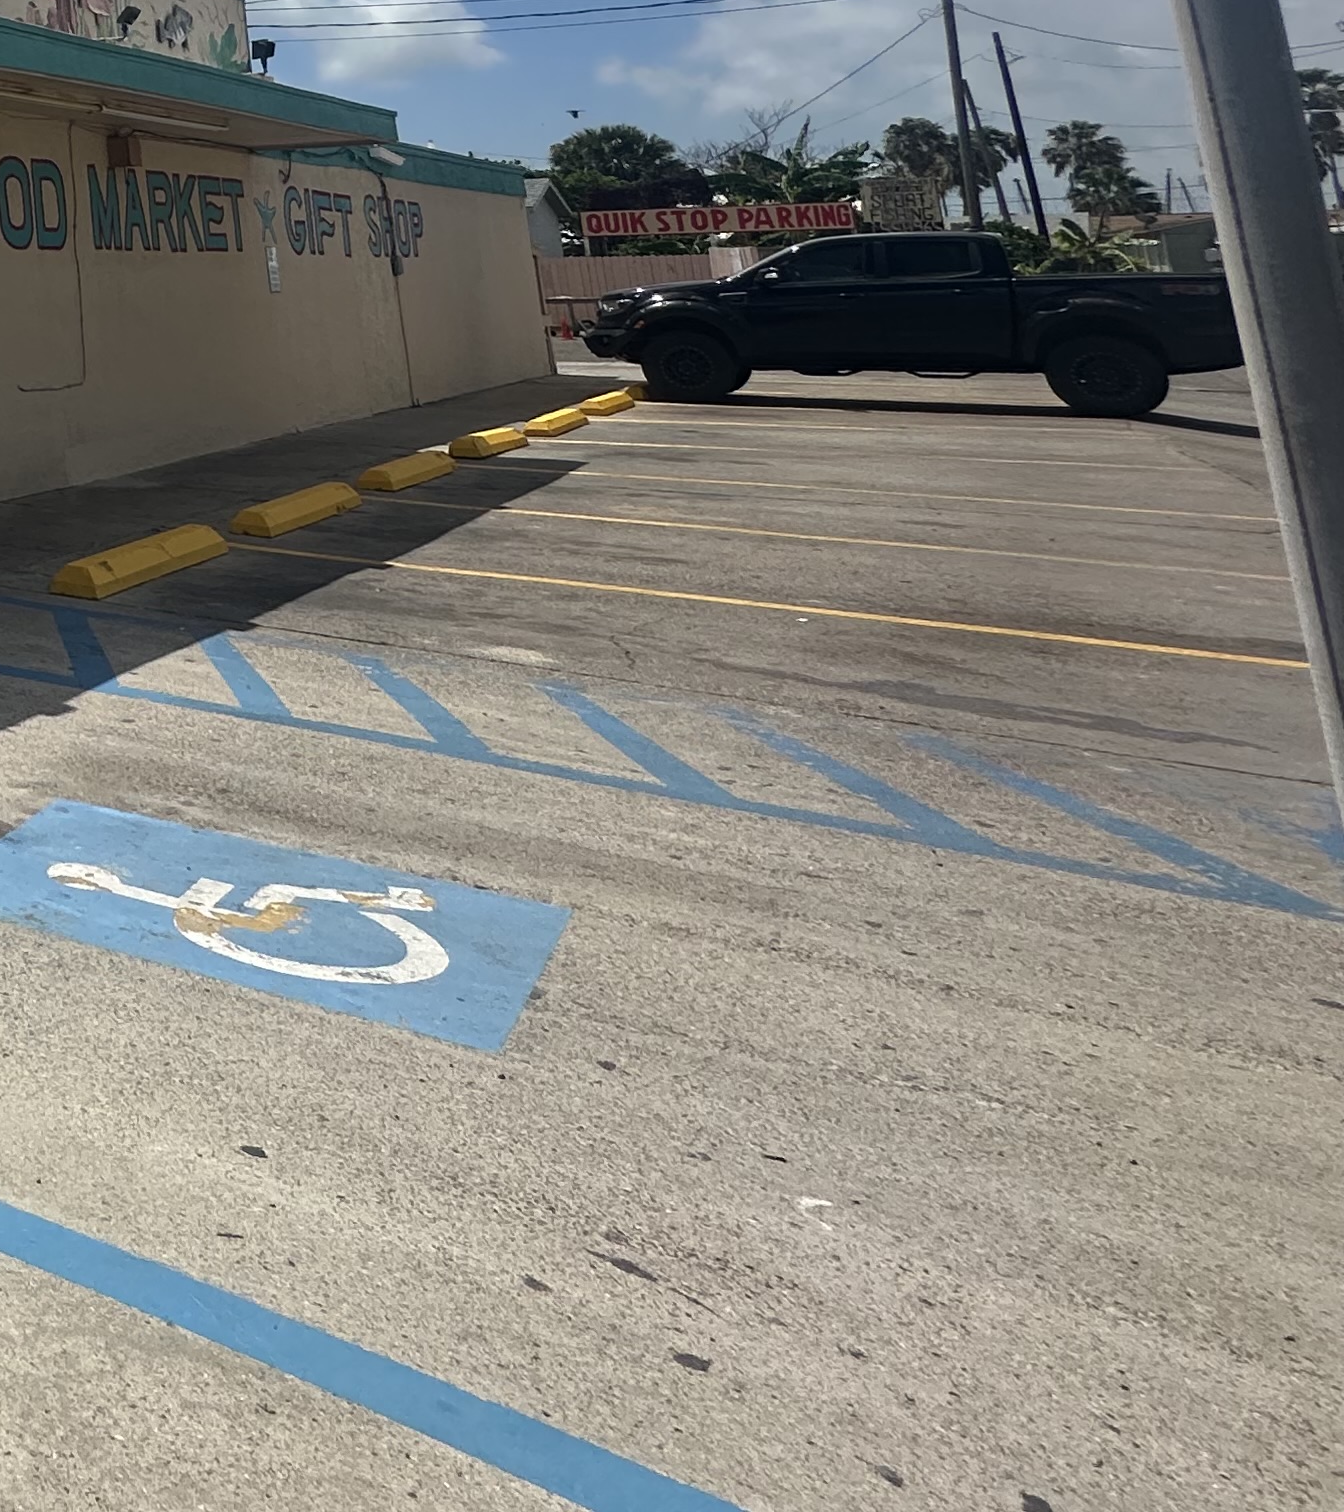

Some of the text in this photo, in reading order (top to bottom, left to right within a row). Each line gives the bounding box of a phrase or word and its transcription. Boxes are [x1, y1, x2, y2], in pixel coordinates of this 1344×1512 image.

[87, 164, 244, 254] MARKET
[283, 186, 353, 258] GIFT
[364, 192, 424, 259] SHOP
[585, 211, 648, 235] QUIK
[656, 209, 729, 233] STOP
[737, 203, 852, 230] PARKING
